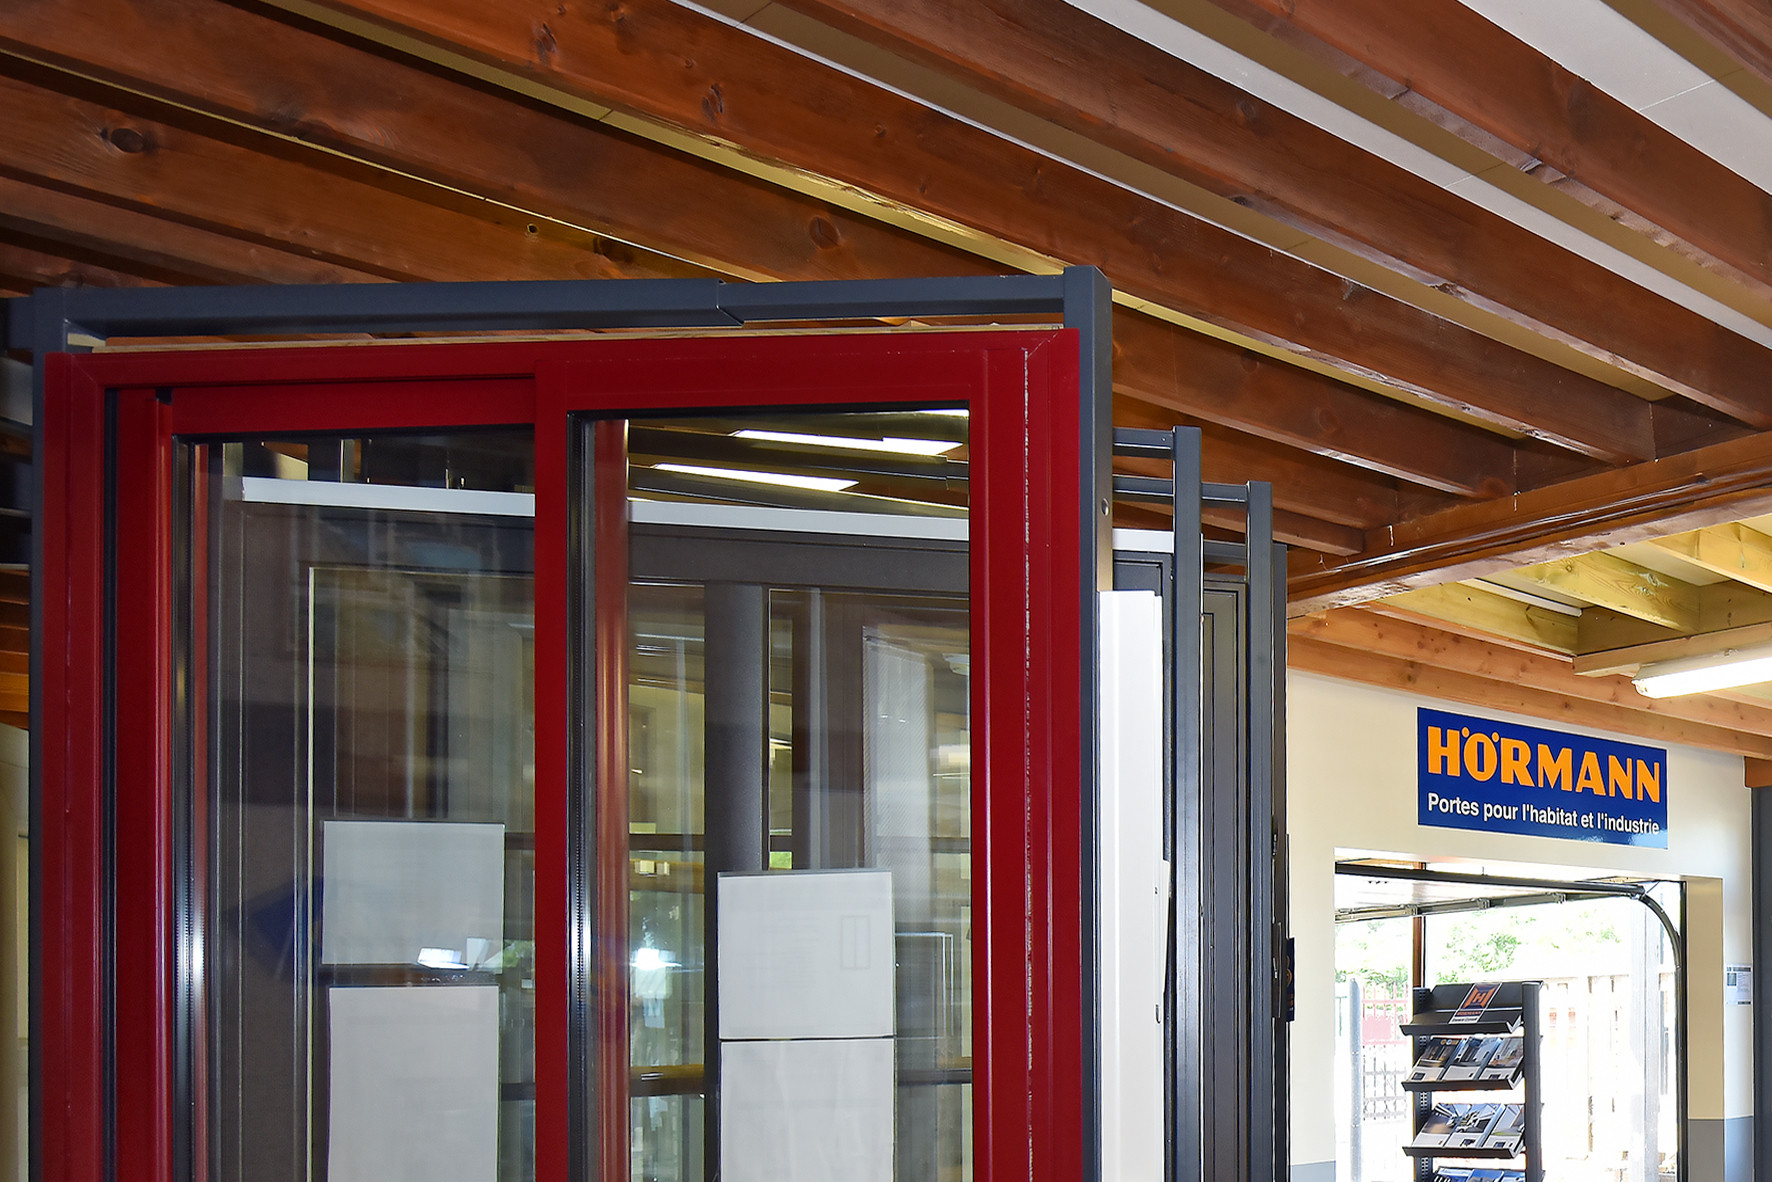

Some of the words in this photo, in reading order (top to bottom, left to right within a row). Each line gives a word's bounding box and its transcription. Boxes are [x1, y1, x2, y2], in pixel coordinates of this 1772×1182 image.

[1428, 726, 1660, 803] HÖRMANN
[1428, 793, 1479, 816] Portes
[1483, 802, 1518, 822] pour
[1522, 804, 1578, 827] l'habitat
[1580, 813, 1594, 828] et
[1597, 812, 1660, 835] l'industrie
